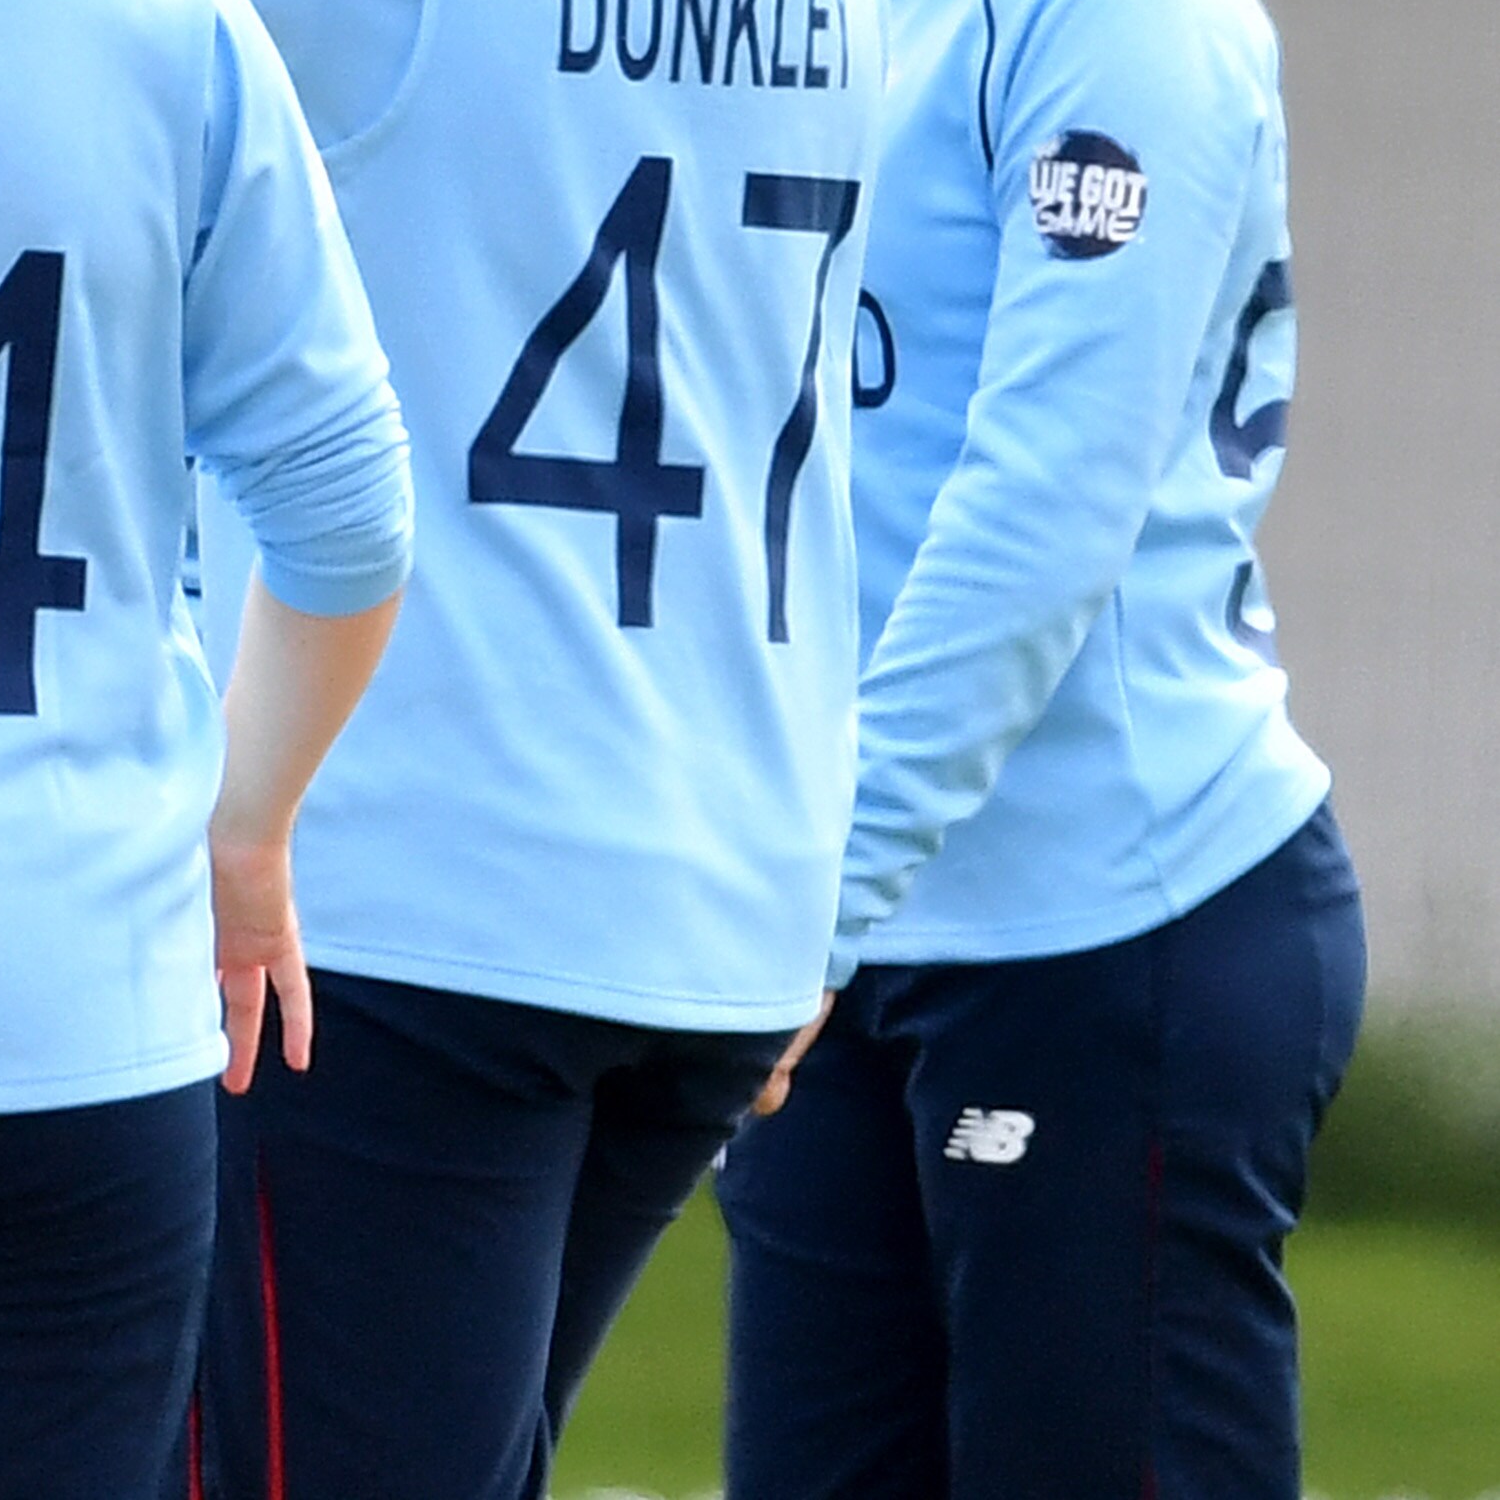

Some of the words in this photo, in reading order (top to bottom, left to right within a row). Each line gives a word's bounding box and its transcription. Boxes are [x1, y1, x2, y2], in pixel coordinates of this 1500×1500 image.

[1029, 160, 1080, 204] WE
[1080, 164, 1149, 217] GOT
[1036, 202, 1137, 243] GAME
[467, 155, 862, 644] 47
